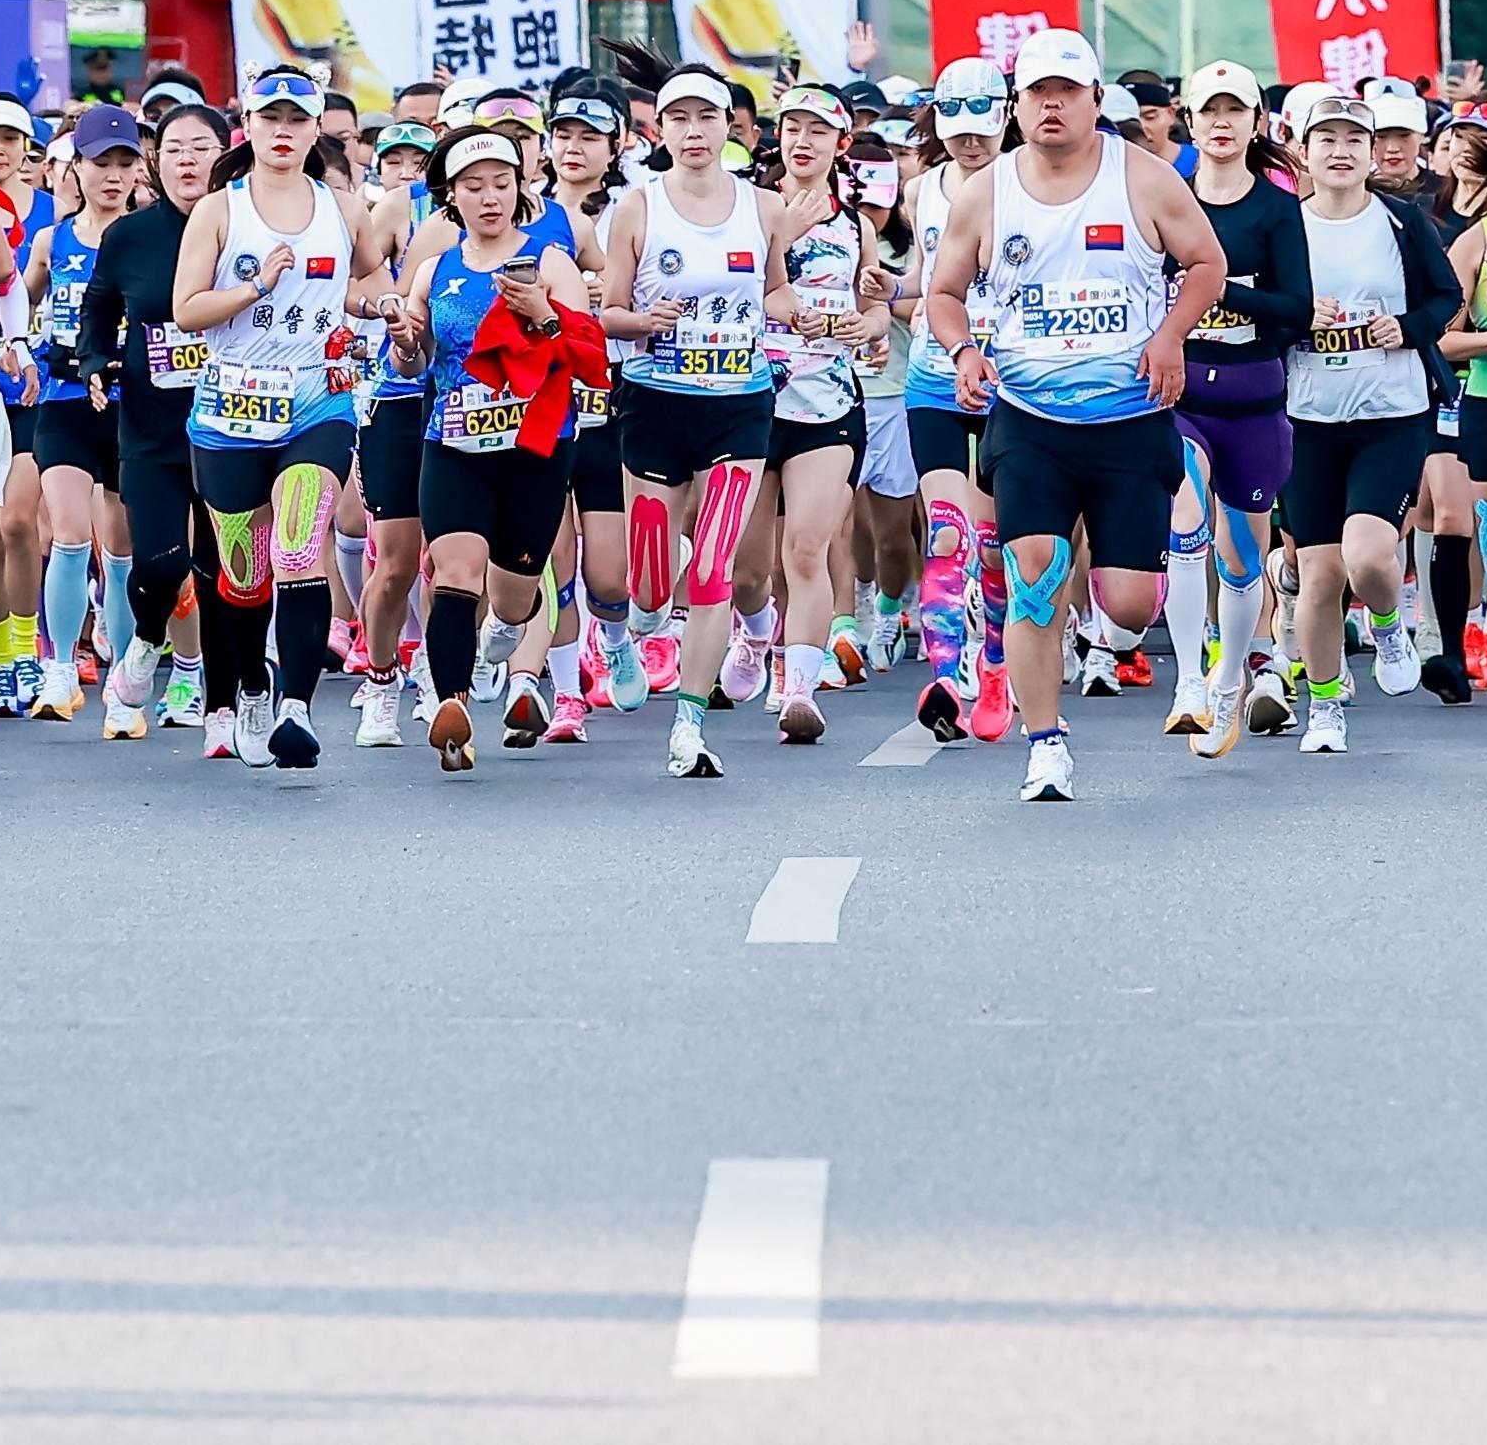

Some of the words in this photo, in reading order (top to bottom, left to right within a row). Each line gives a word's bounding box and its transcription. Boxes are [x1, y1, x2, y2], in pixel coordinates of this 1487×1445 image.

[229, 304, 332, 335] 國警察
[662, 296, 753, 324] 國警察
[1048, 305, 1125, 336] 22903
[679, 349, 751, 374] 35142
[220, 393, 291, 424] 32613
[466, 405, 528, 436] 6204
